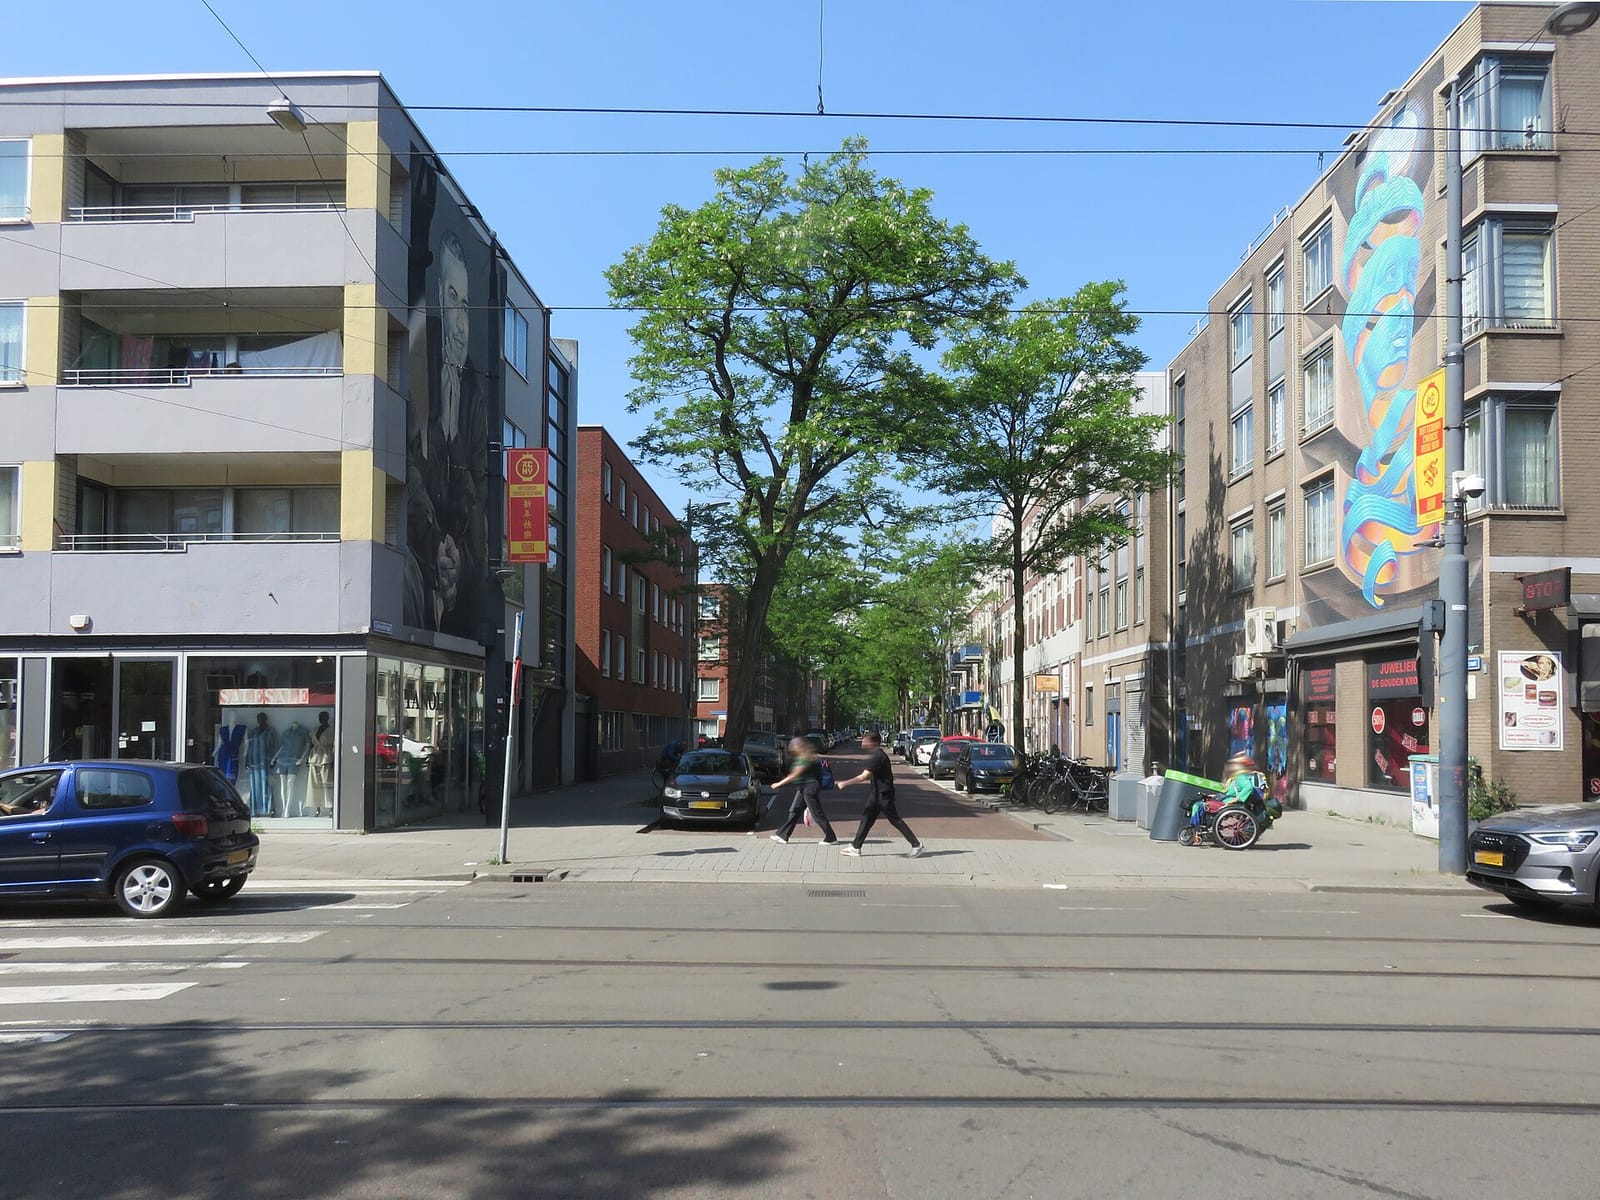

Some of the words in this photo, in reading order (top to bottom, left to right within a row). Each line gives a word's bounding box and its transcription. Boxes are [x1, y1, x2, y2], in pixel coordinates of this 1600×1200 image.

[1379, 660, 1417, 674] JUWELIER
[1380, 677, 1404, 688] GOUDEN
[1405, 675, 1418, 687] KRO
[220, 689, 263, 704] SALE
[264, 688, 308, 704] SALE
